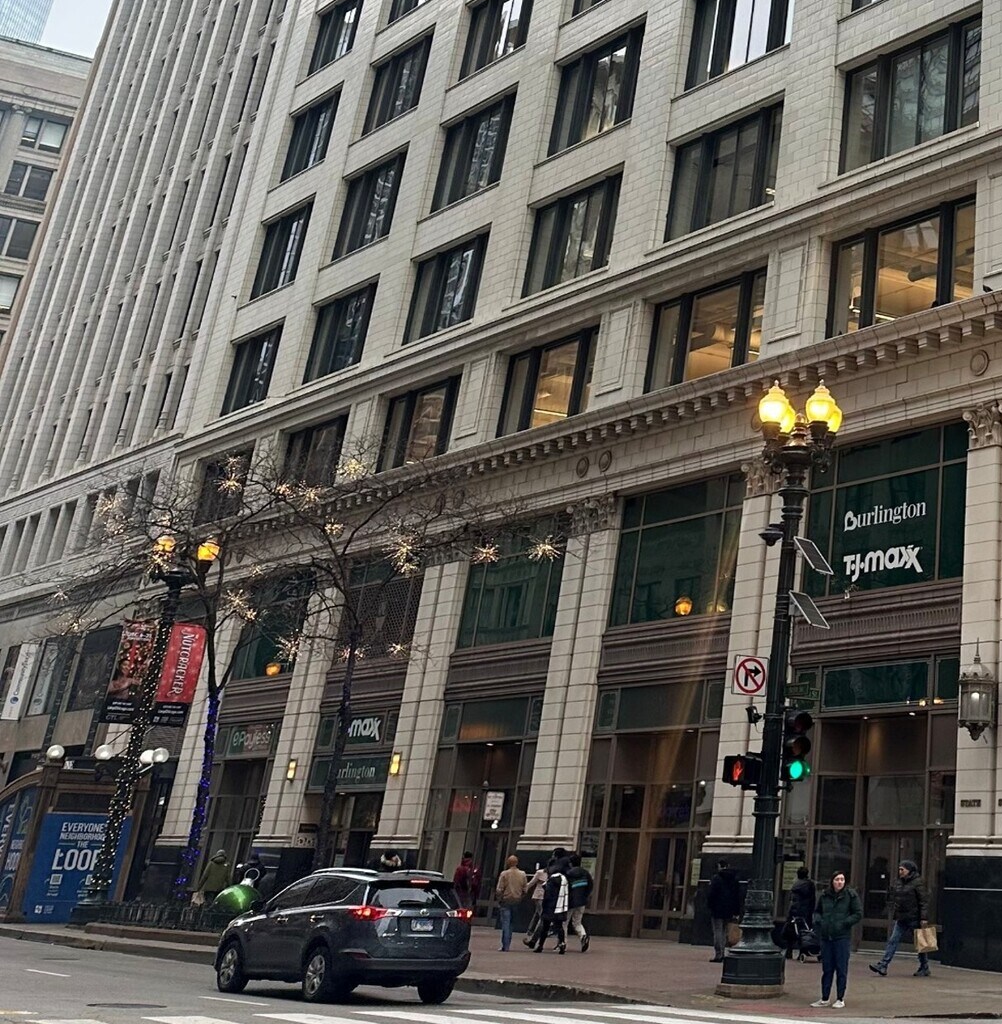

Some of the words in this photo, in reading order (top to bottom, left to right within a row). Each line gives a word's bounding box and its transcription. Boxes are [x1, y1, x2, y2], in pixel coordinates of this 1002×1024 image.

[844, 501, 926, 532] Burlington
[167, 628, 196, 697] NUTCRACKER
[336, 762, 375, 784] rlington
[960, 799, 981, 808] STATE
[59, 832, 105, 841] NEIGHBORHO
[77, 840, 89, 848] THE
